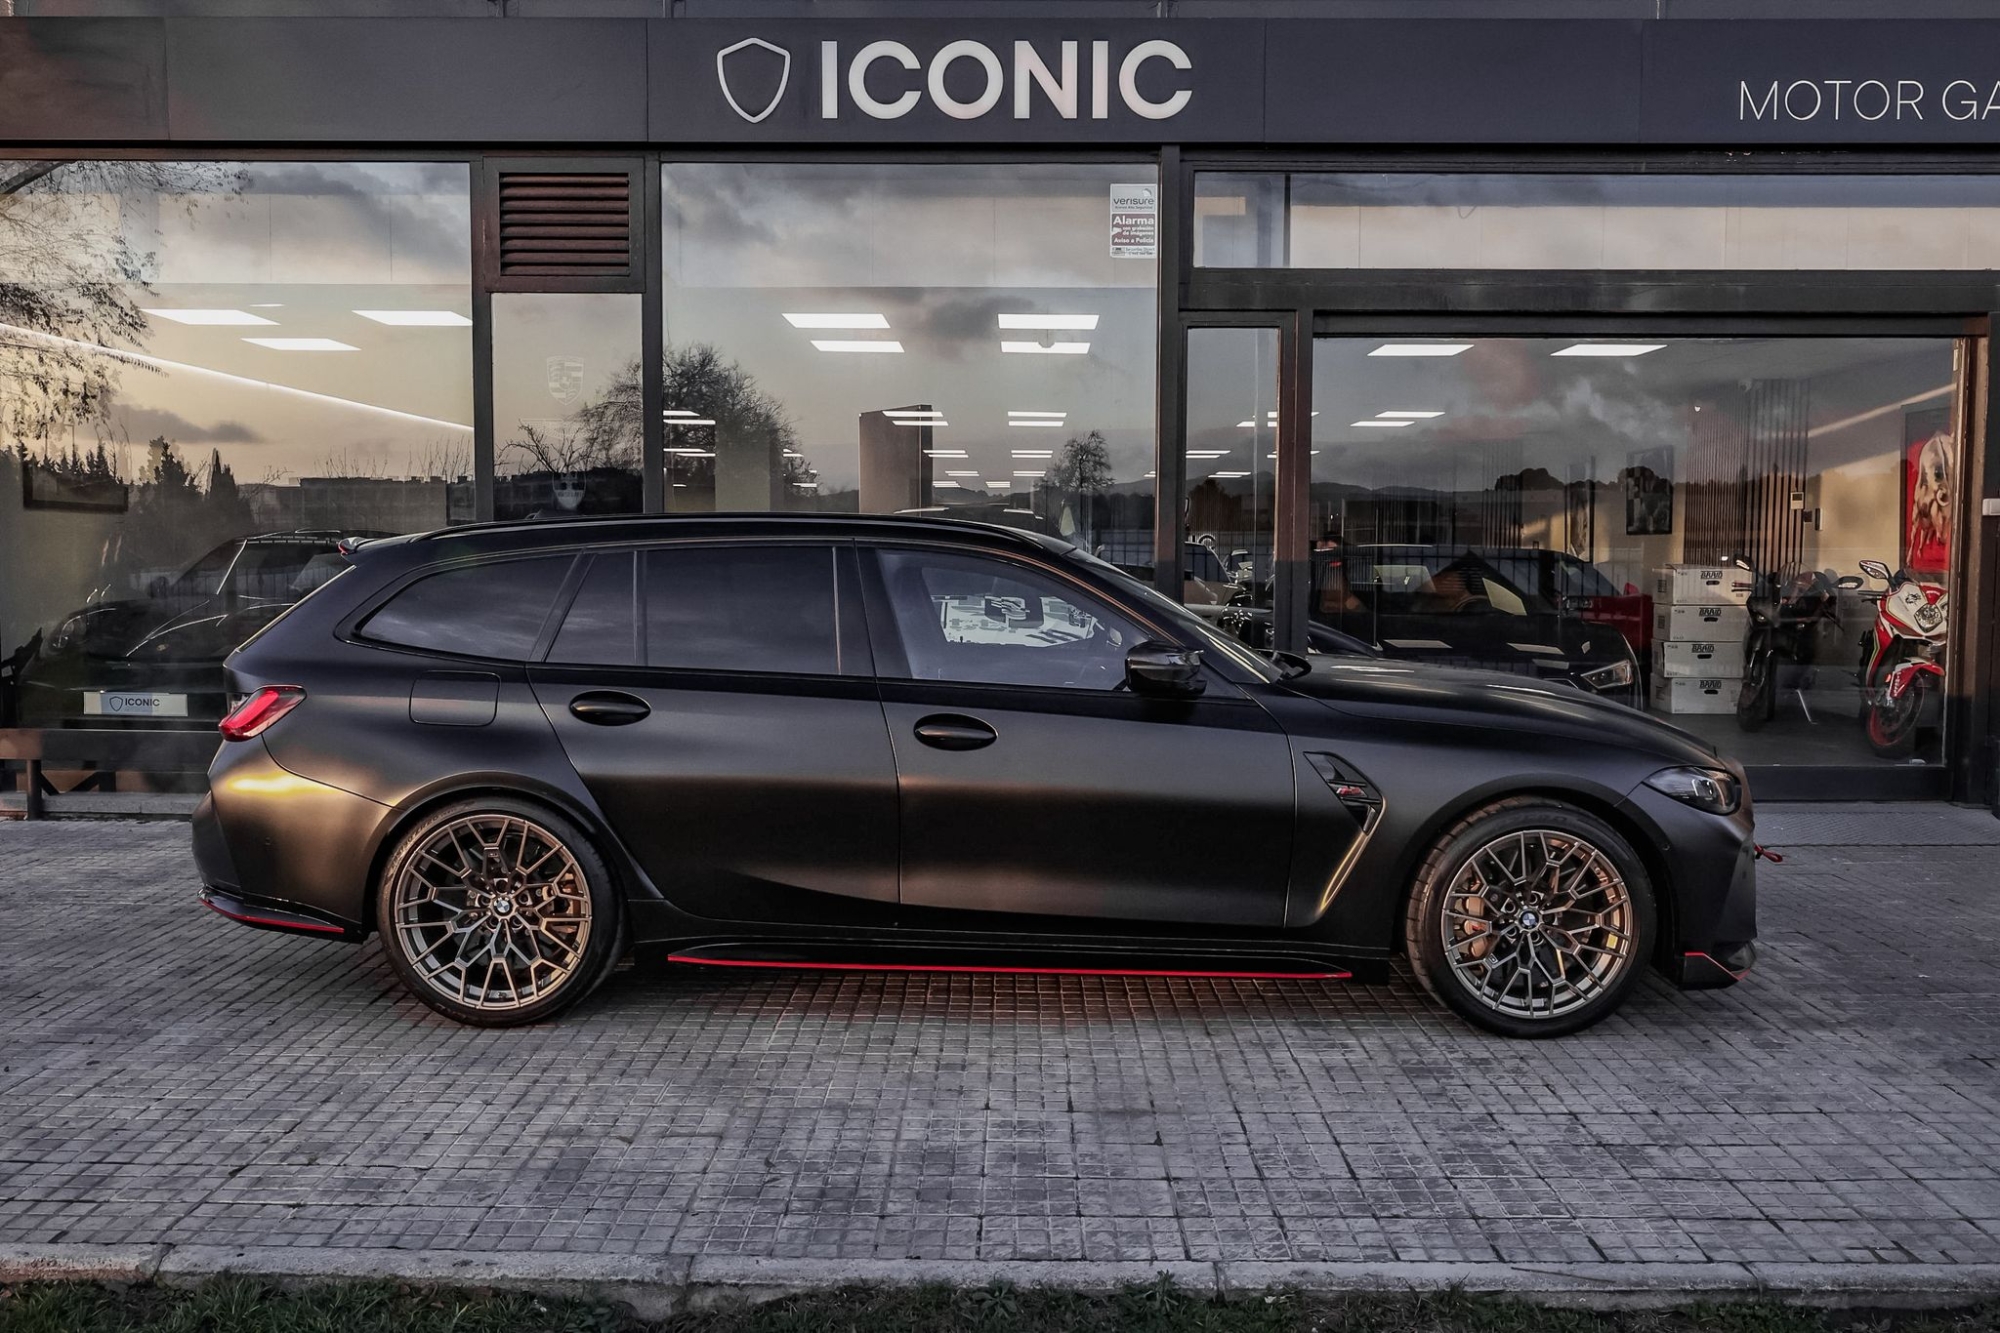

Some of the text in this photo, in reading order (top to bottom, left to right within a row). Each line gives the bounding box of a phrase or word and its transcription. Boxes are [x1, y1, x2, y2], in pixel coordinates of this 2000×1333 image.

[821, 39, 1193, 120] ICONIC
[1739, 80, 1925, 121] MOTOR
[1113, 215, 1154, 225] Alarma
[125, 698, 160, 706] ICONIC
